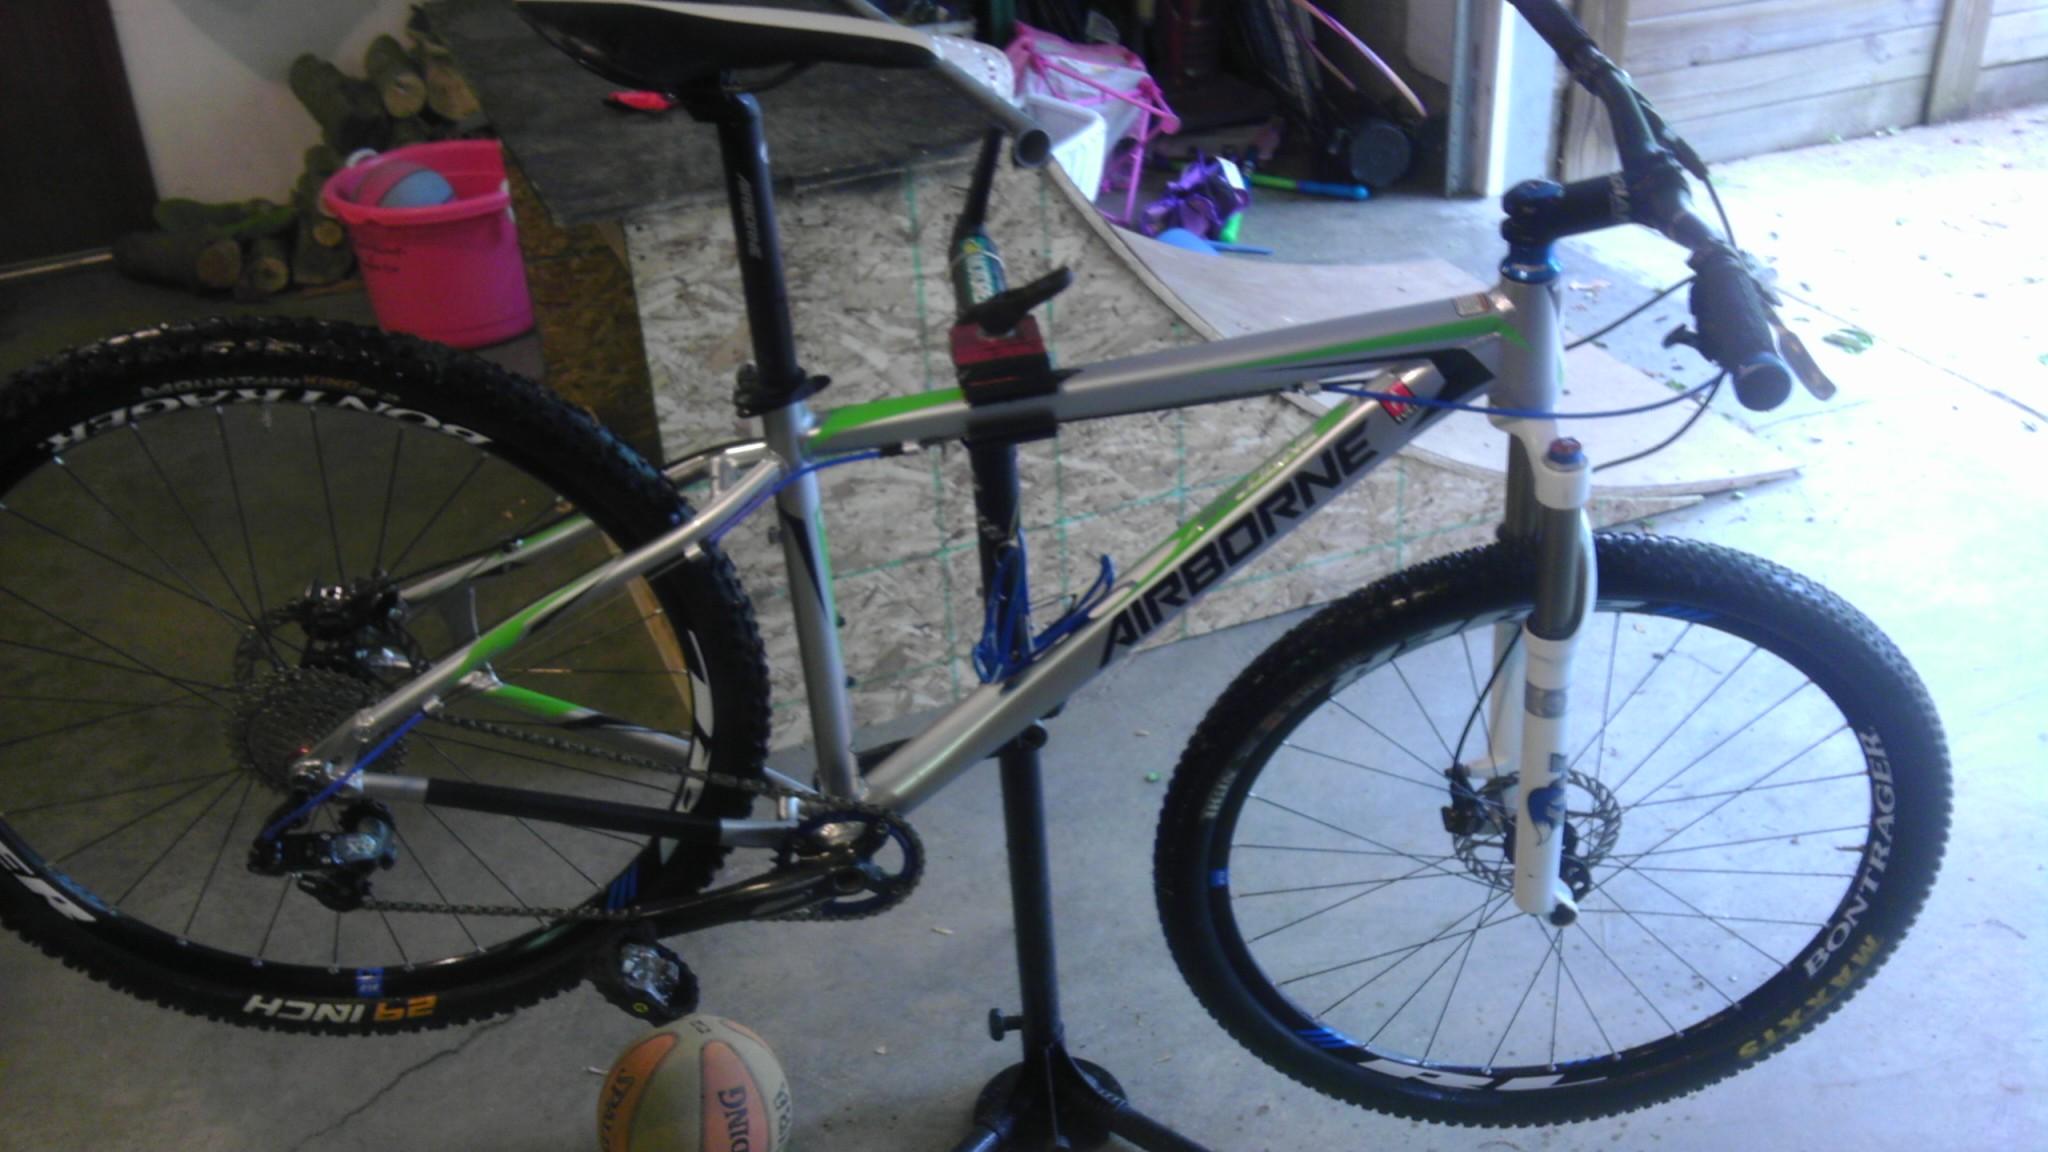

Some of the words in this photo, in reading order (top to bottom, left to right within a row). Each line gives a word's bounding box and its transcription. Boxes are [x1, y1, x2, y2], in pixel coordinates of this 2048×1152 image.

[140, 375, 301, 398] MOUNTAIN
[46, 388, 493, 453] BONTRAGER
[1100, 421, 1378, 669] AIRBORNE
[1803, 726, 1896, 977] BONTRAGER
[242, 994, 366, 1023] INCH
[372, 994, 438, 1022] 29
[1738, 934, 1883, 1060] MAXXIS
